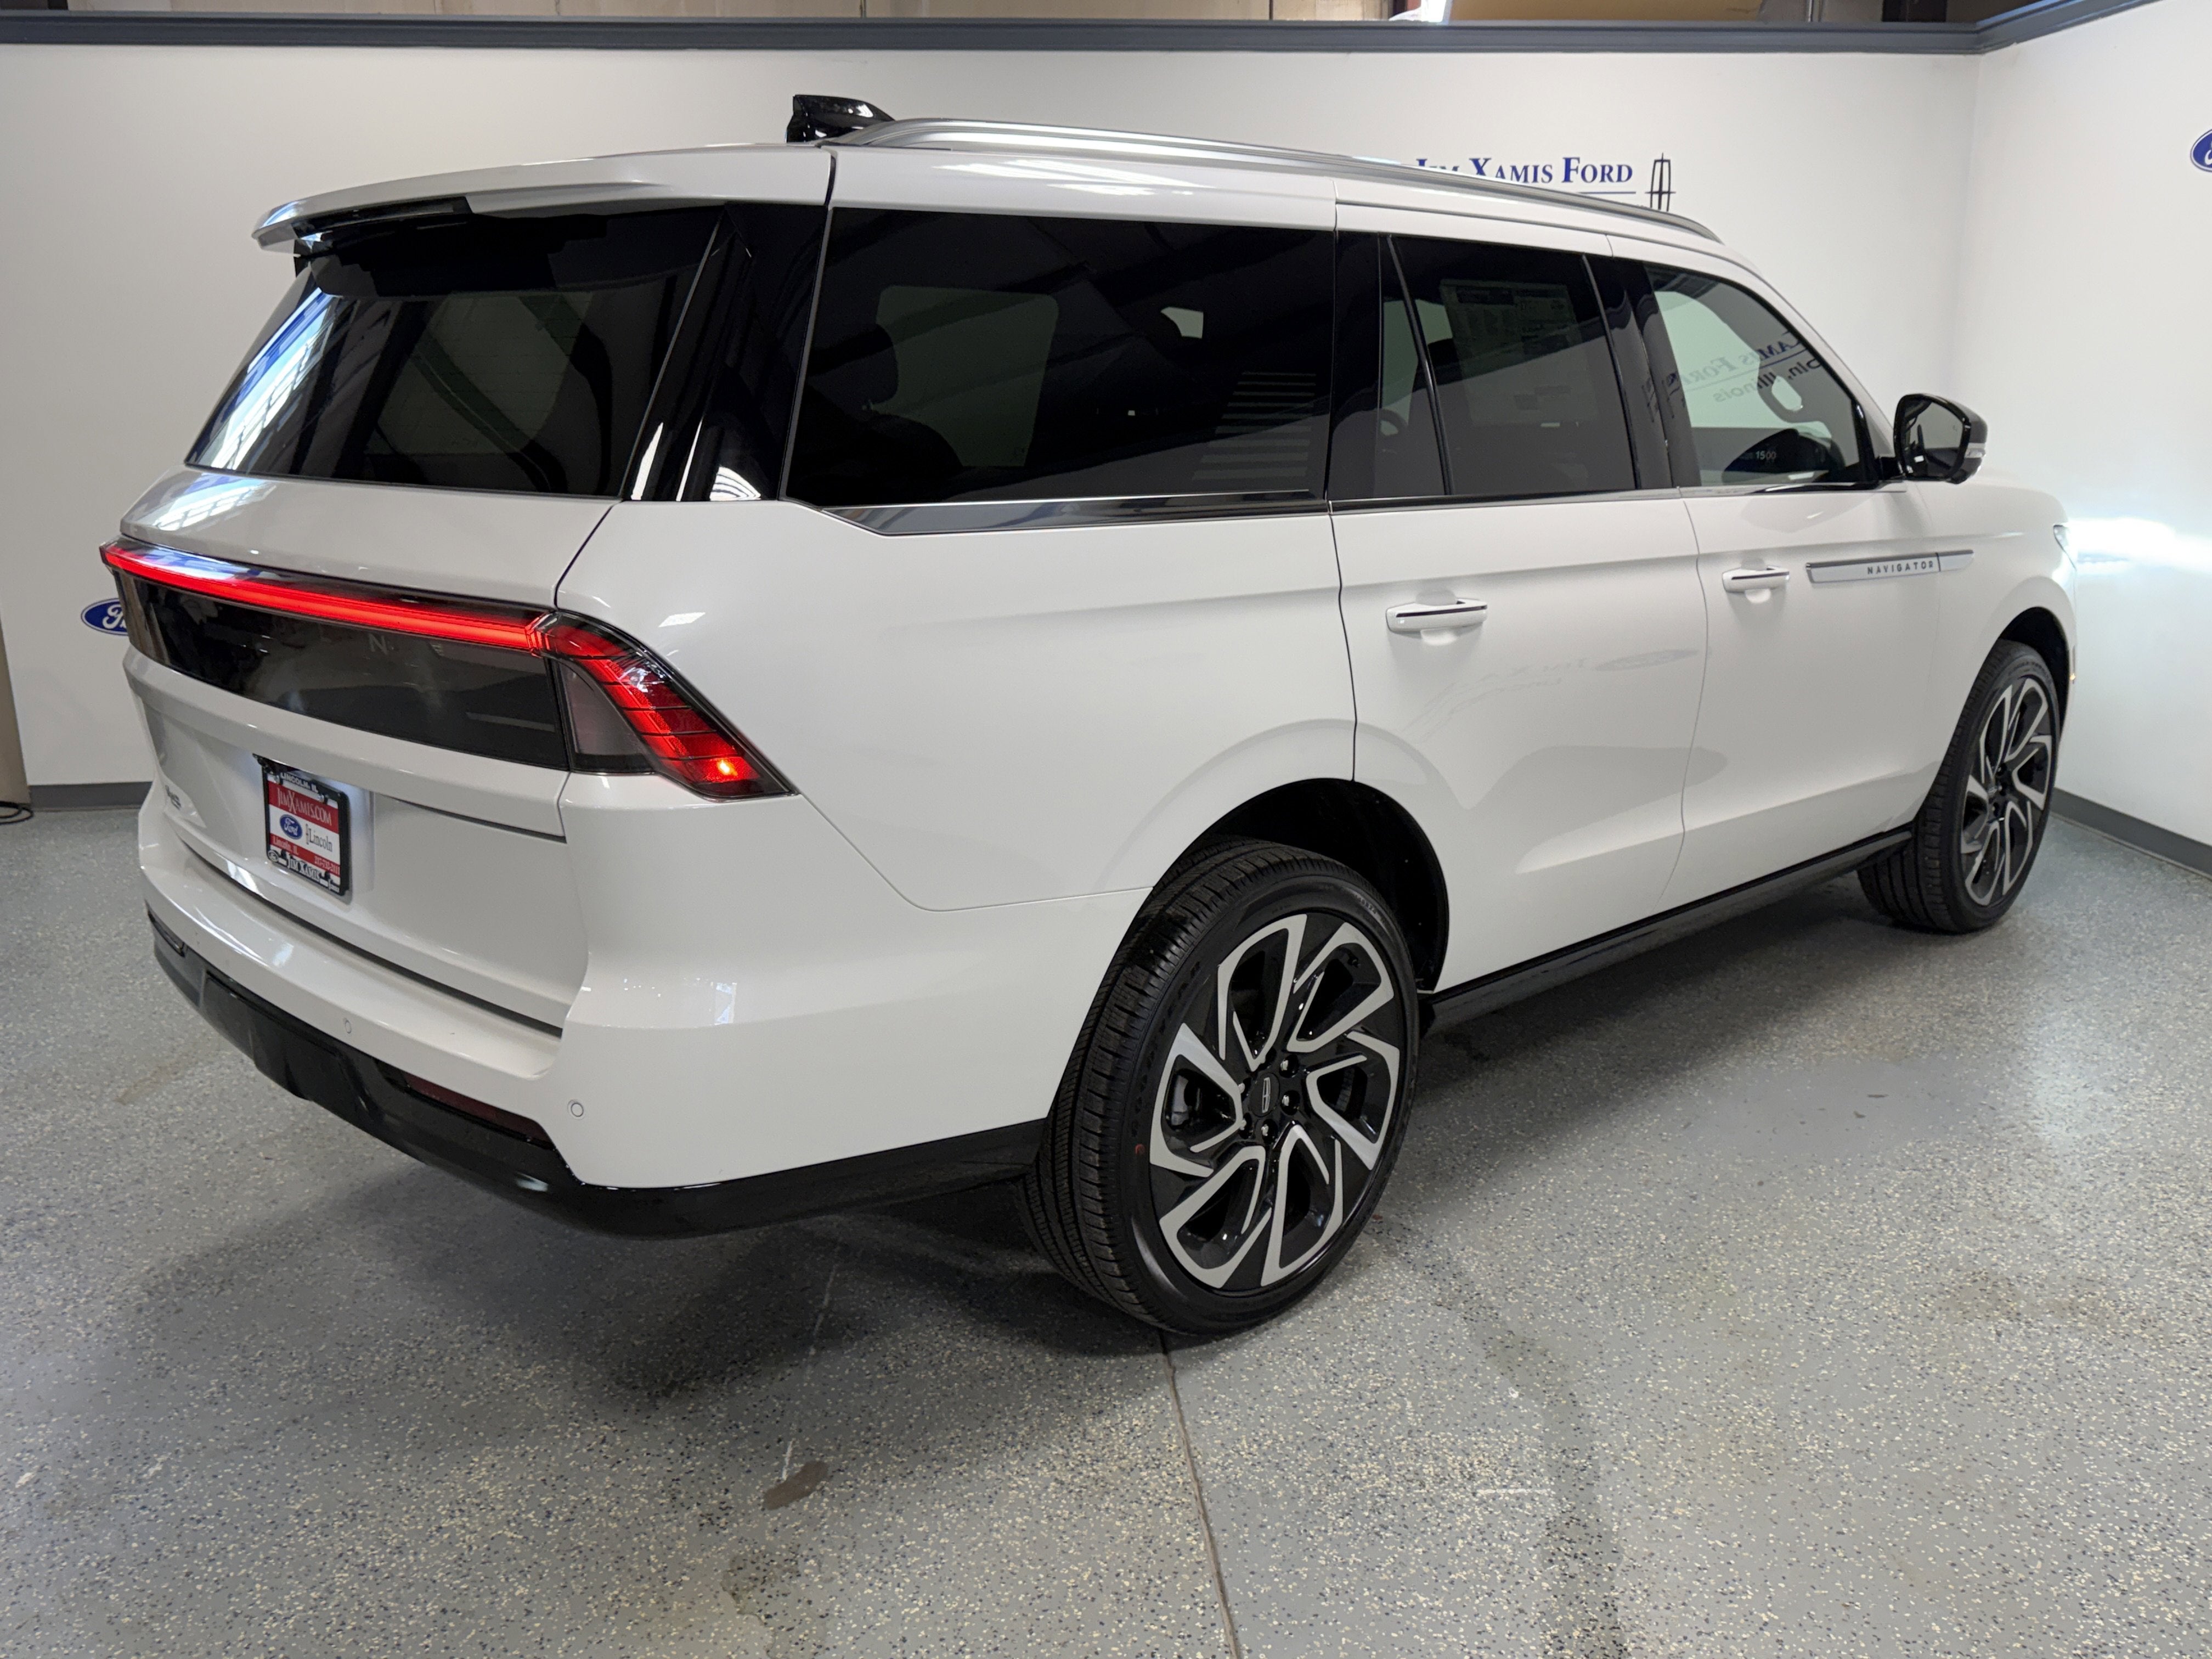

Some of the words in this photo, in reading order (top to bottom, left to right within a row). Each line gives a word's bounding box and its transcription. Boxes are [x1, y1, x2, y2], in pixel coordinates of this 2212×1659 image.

[1561, 156, 1633, 184] FORD
[1867, 560, 1934, 575] NAVIGATOR
[284, 817, 299, 836] Ford
[308, 828, 332, 853] Lincoln
